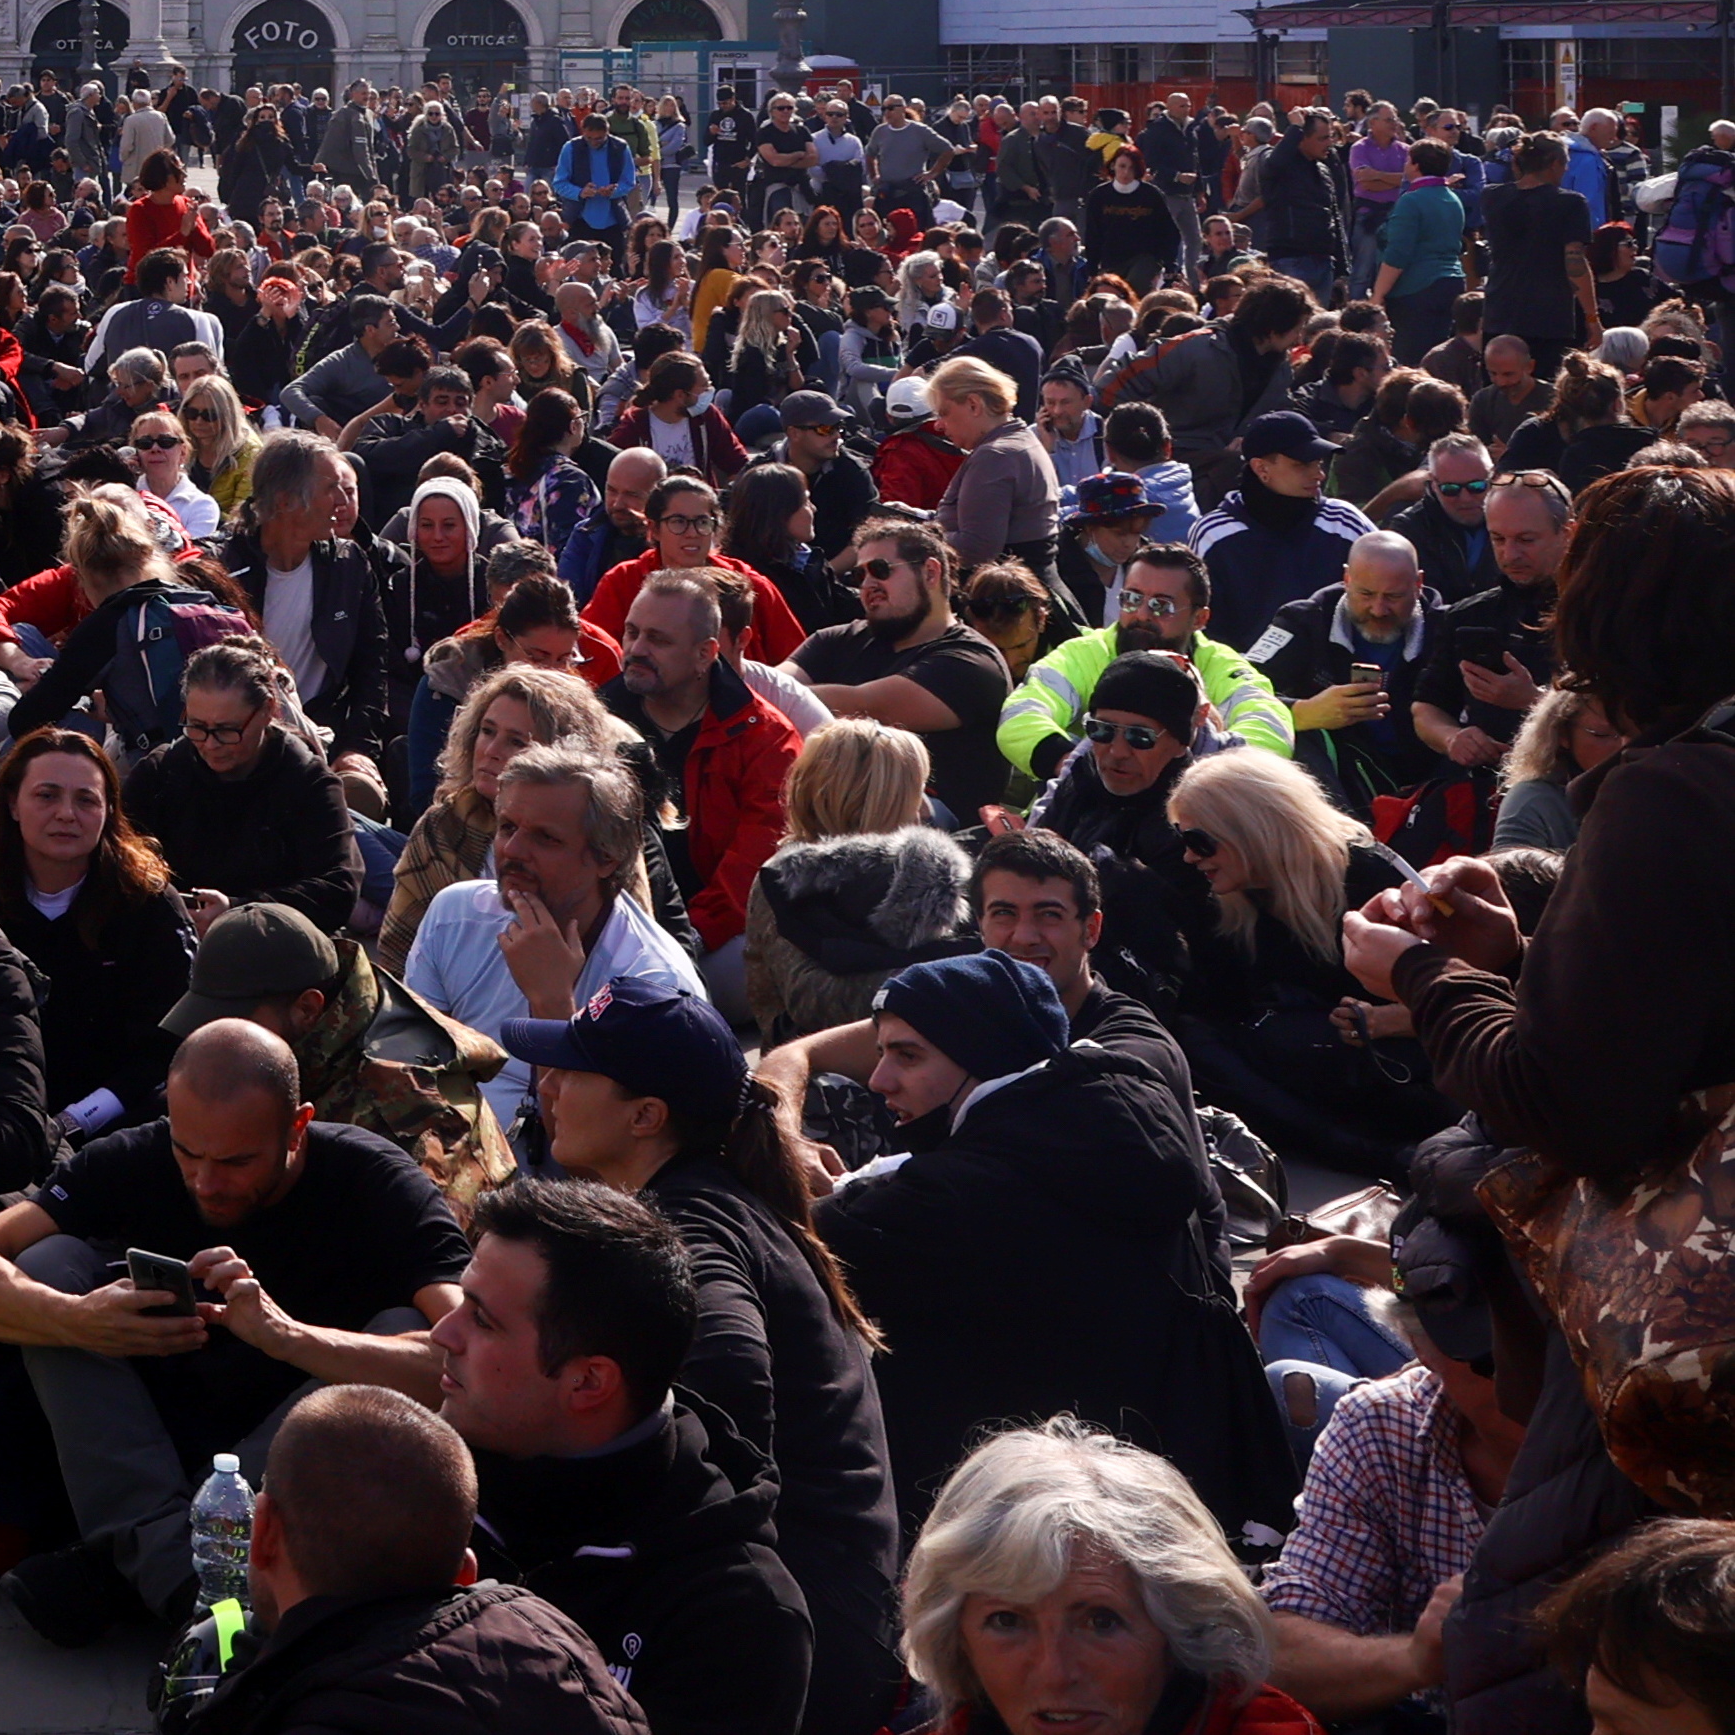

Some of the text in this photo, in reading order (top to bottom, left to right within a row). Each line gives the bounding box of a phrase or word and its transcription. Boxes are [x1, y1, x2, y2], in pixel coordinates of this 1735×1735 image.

[244, 20, 318, 50] FOTO
[447, 34, 506, 46] OTTICA
[56, 39, 114, 50] OTCA
